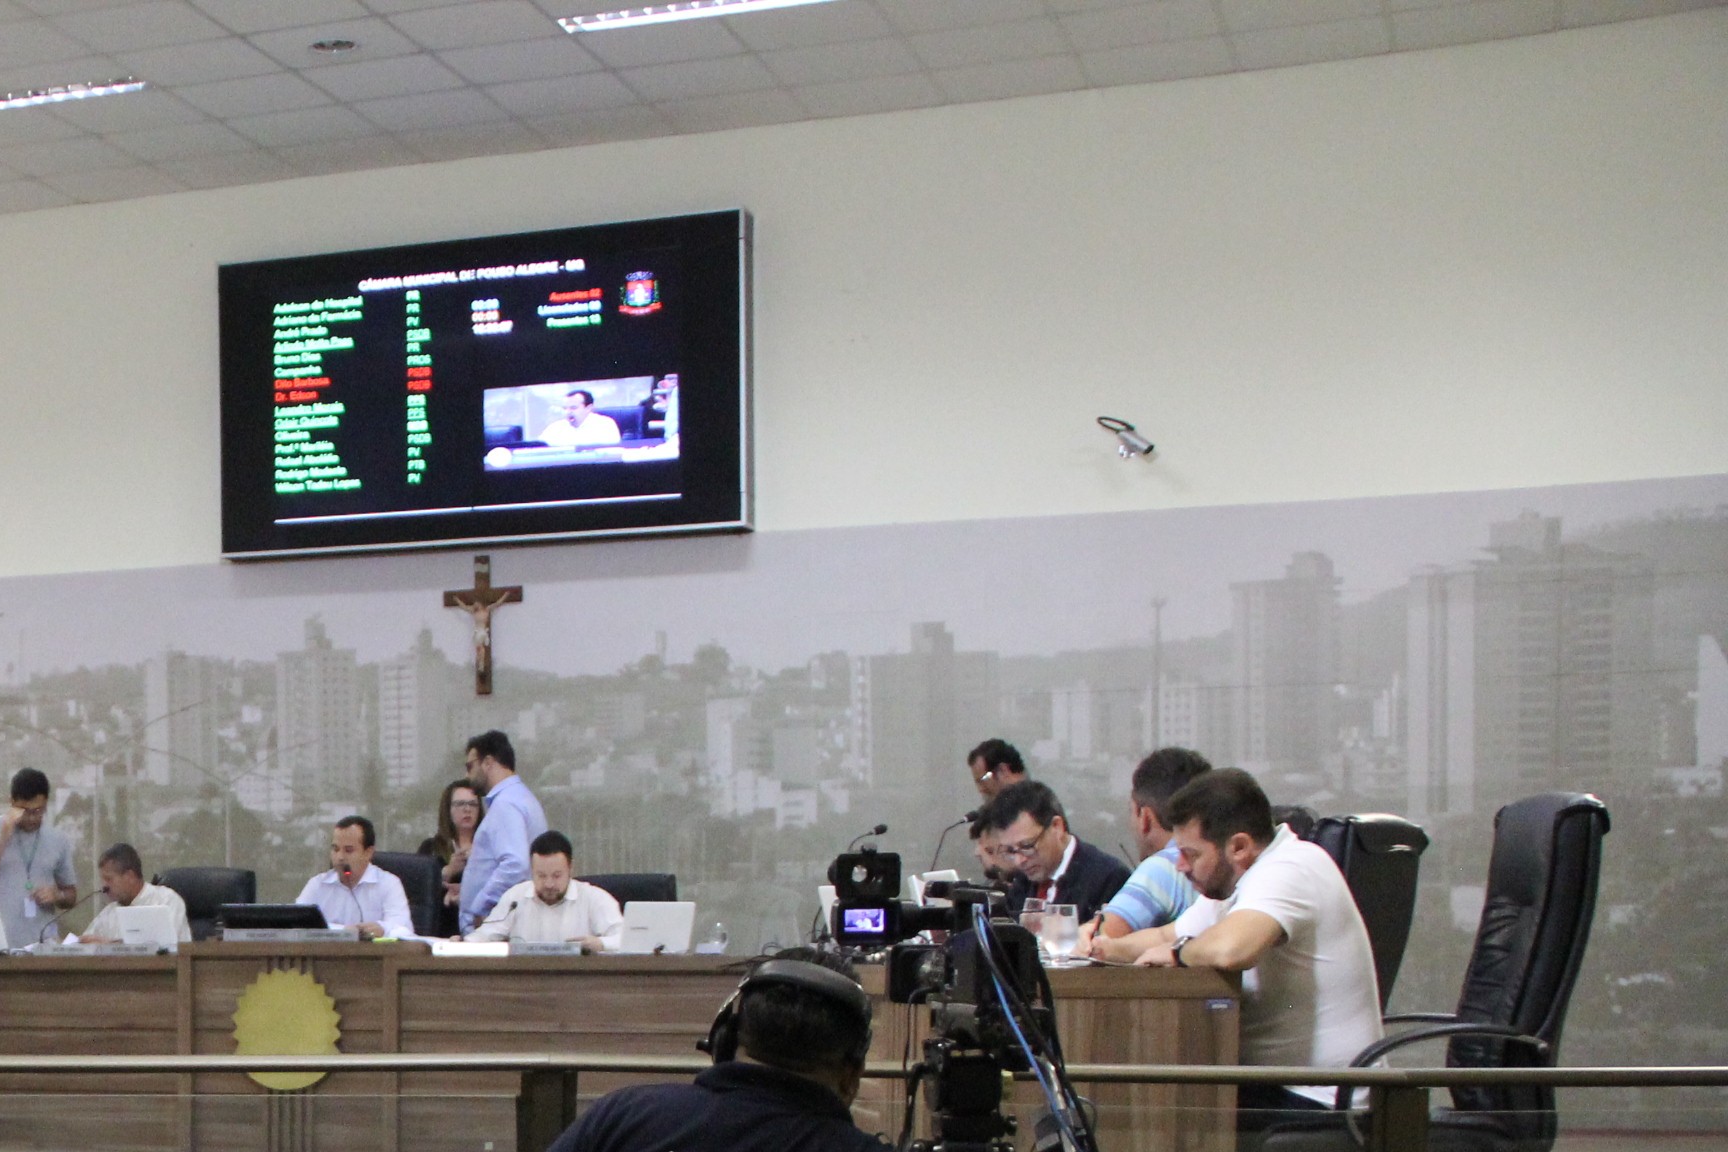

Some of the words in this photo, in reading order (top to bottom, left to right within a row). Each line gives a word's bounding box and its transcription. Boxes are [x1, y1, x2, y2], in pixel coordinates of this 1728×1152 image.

[403, 271, 458, 287] MUNICIPAL
[459, 269, 475, 282] DE
[289, 390, 319, 402] Edson
